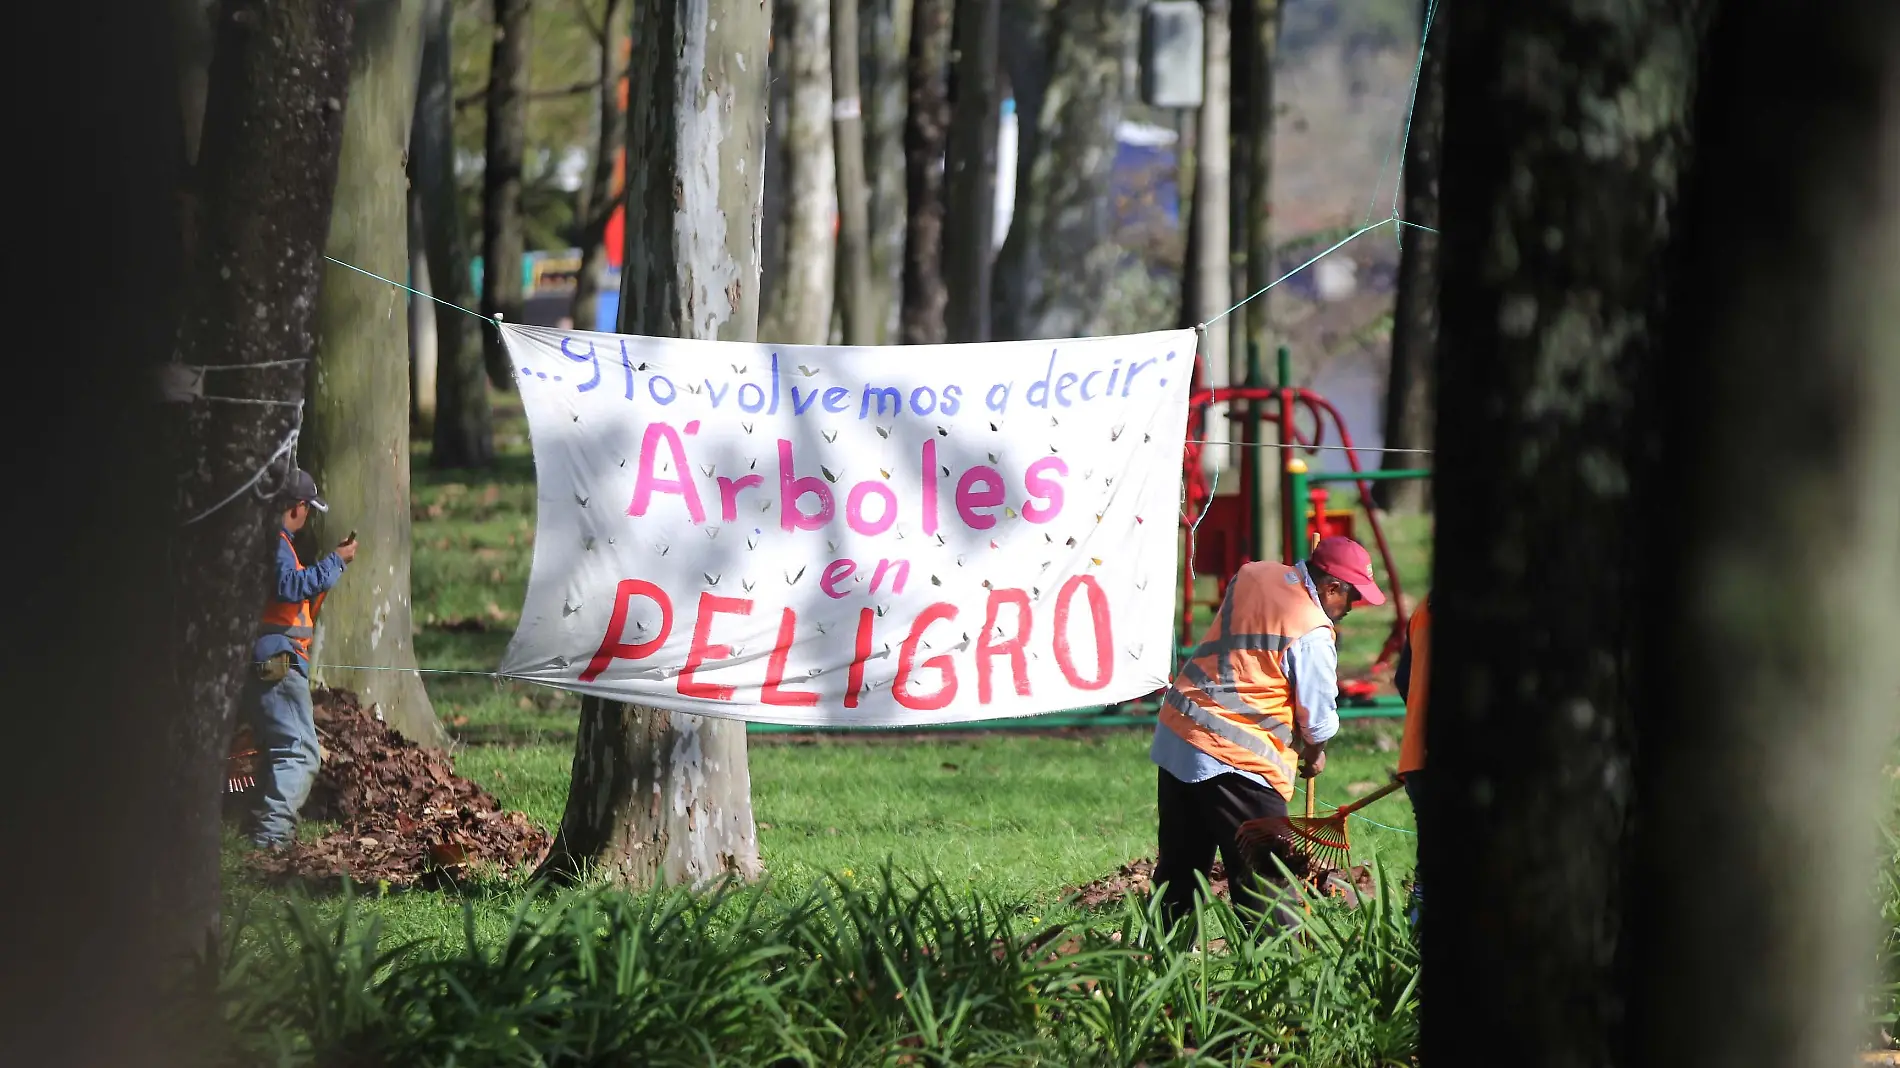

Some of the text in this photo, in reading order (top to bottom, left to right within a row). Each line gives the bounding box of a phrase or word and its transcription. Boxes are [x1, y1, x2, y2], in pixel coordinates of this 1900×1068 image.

[619, 339, 678, 405] lo
[705, 352, 963, 420] volvemos
[985, 380, 1014, 414] a
[1026, 348, 1176, 409] decir:
[624, 419, 1069, 537] Árboles
[820, 558, 911, 599] en
[578, 574, 1114, 711] PELIGRO
